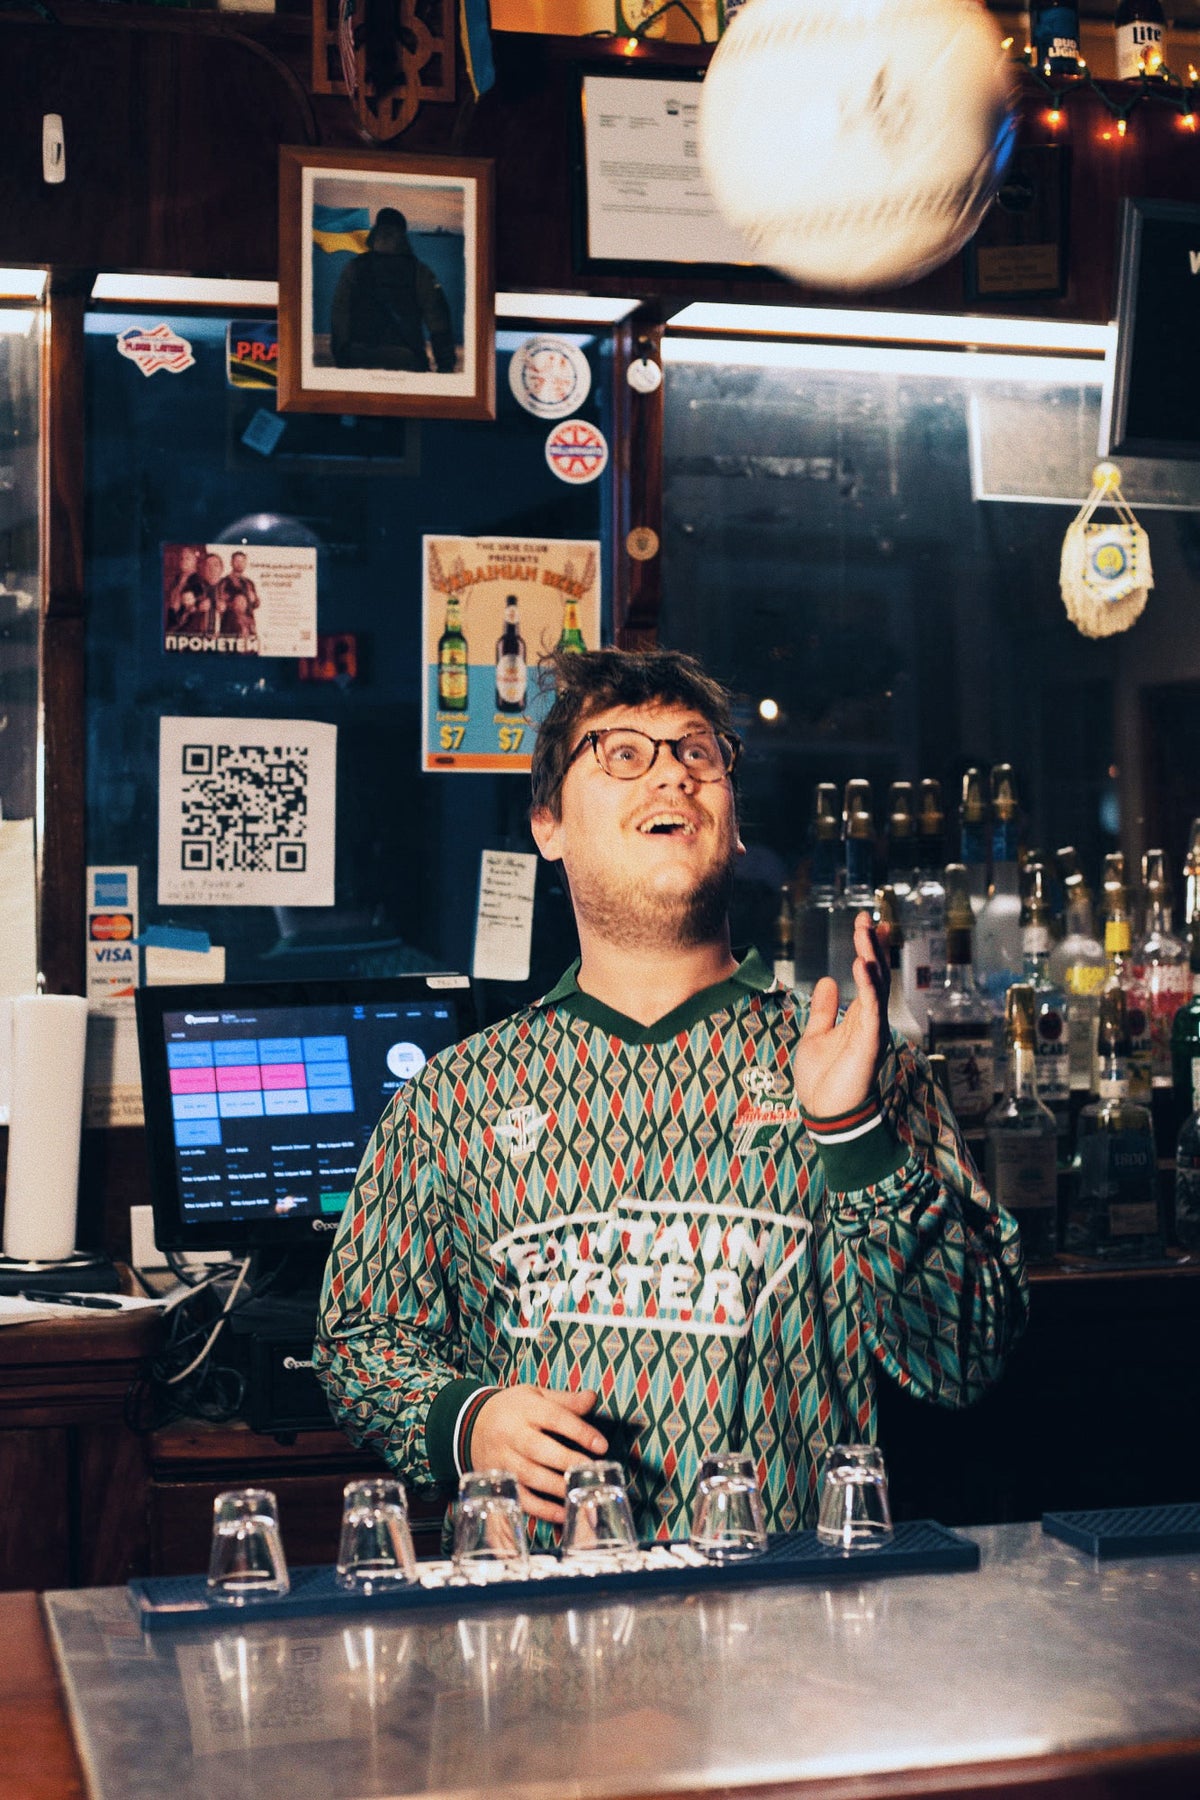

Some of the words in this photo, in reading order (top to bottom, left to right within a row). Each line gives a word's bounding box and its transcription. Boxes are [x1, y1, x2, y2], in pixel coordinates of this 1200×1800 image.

[1053, 37, 1077, 49] BUD
[1133, 26, 1162, 45] Lite
[165, 635, 260, 652] ПРОМЕТЕЙ
[440, 725, 465, 750] $7
[499, 727, 524, 752] $7
[93, 947, 132, 962] VISA
[1114, 1152, 1147, 1166] 1800
